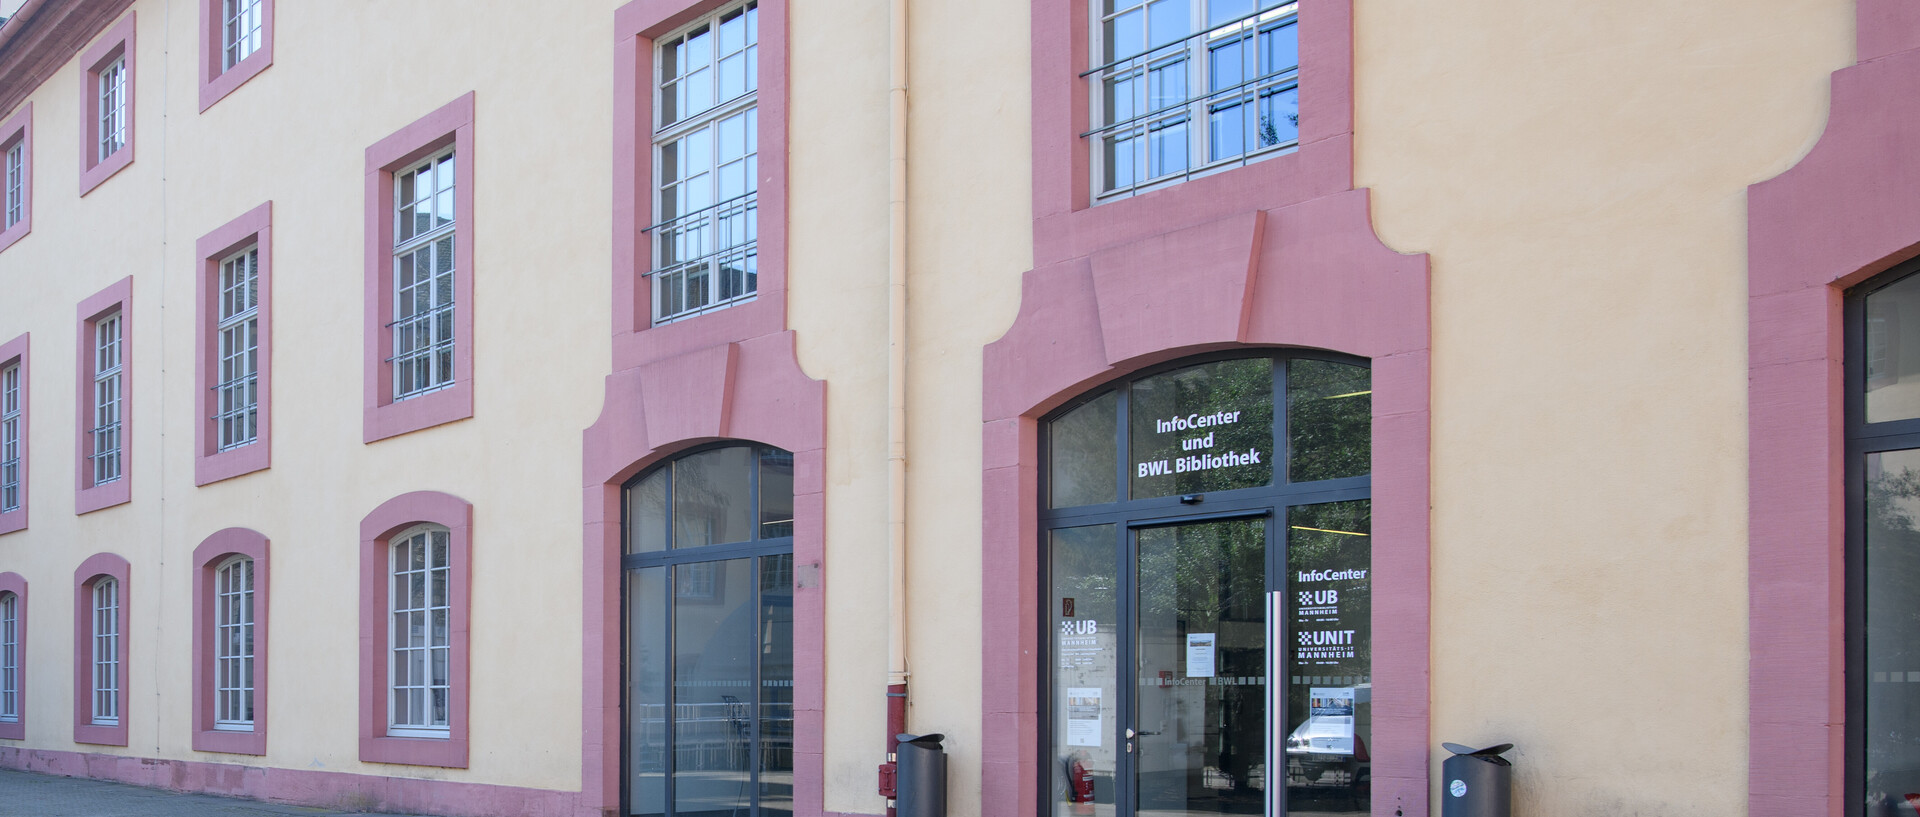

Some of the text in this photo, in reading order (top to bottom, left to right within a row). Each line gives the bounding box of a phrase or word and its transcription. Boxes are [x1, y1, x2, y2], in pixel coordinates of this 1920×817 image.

[1156, 411, 1240, 434] InfoCenter
[1182, 432, 1214, 451] und
[1138, 448, 1261, 478] BWL Bibliothek
[1298, 569, 1367, 582] InfoCenter
[1314, 590, 1338, 605] UB
[1076, 620, 1097, 635] UB
[1312, 630, 1355, 645] UNIT
[1298, 651, 1354, 659] MANNHEIM
[1164, 676, 1237, 686] InfoCenter BWL
